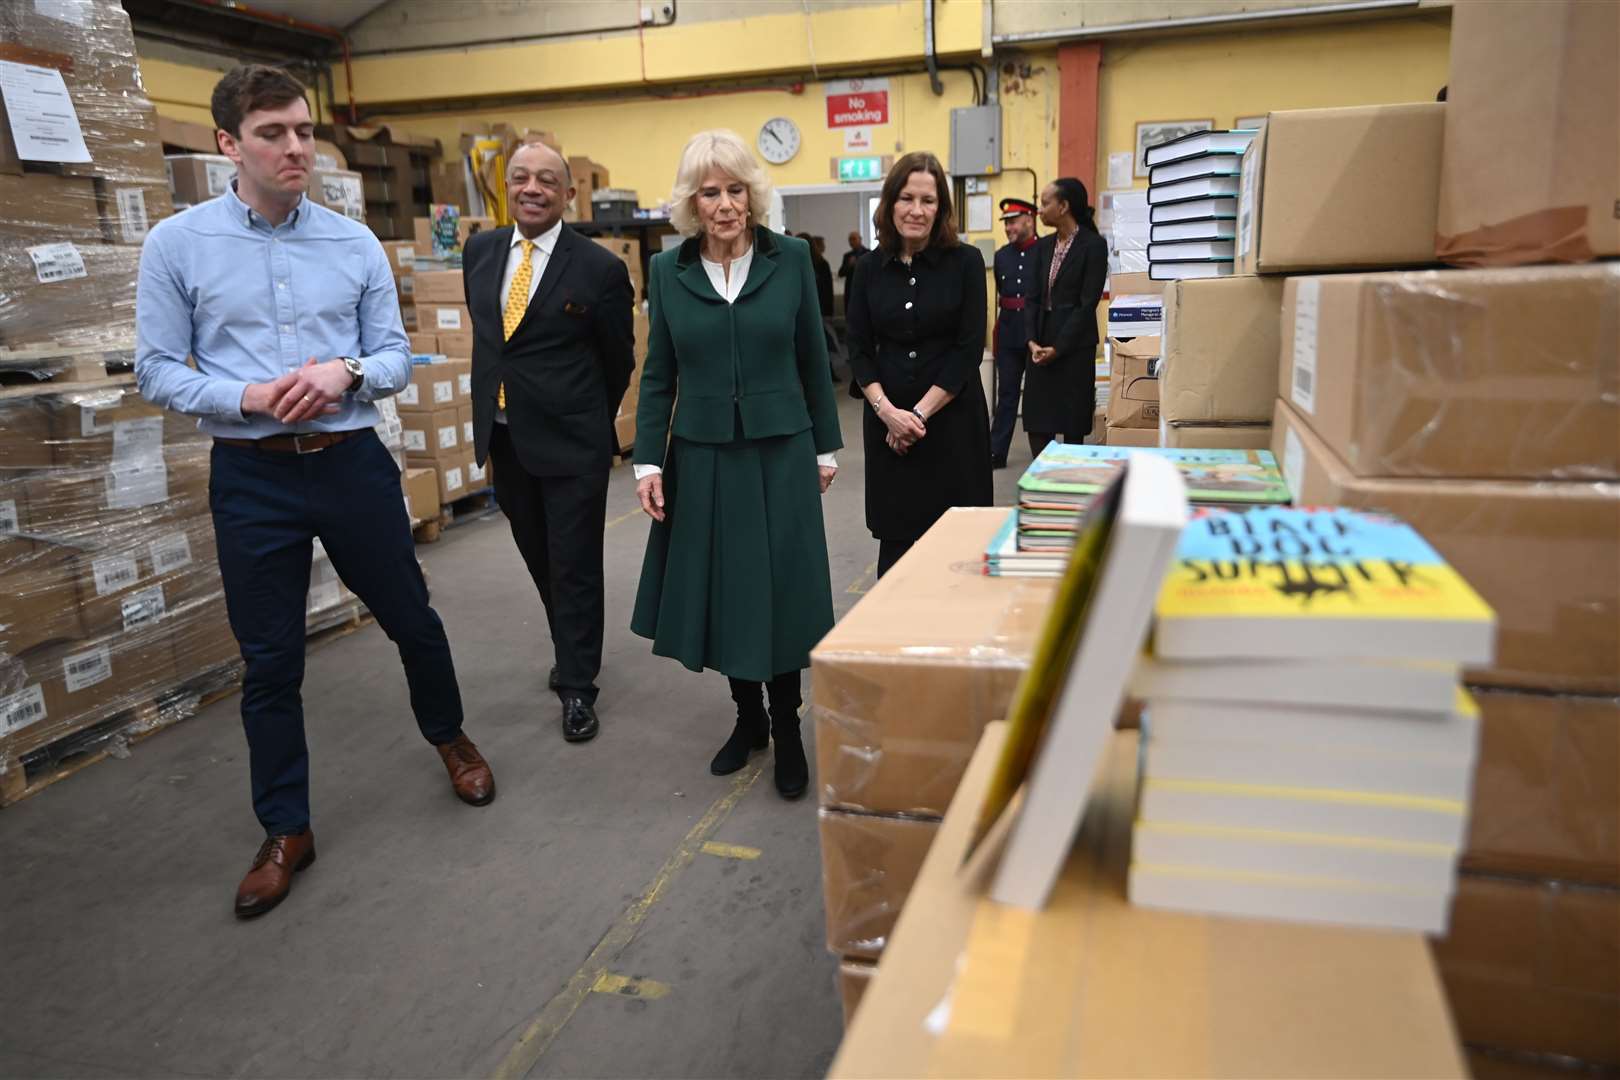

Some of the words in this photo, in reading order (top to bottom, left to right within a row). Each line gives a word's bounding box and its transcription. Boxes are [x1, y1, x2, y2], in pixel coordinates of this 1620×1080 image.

[848, 97, 865, 109] No
[833, 110, 882, 123] smoking
[1206, 514, 1356, 538] BLACK
